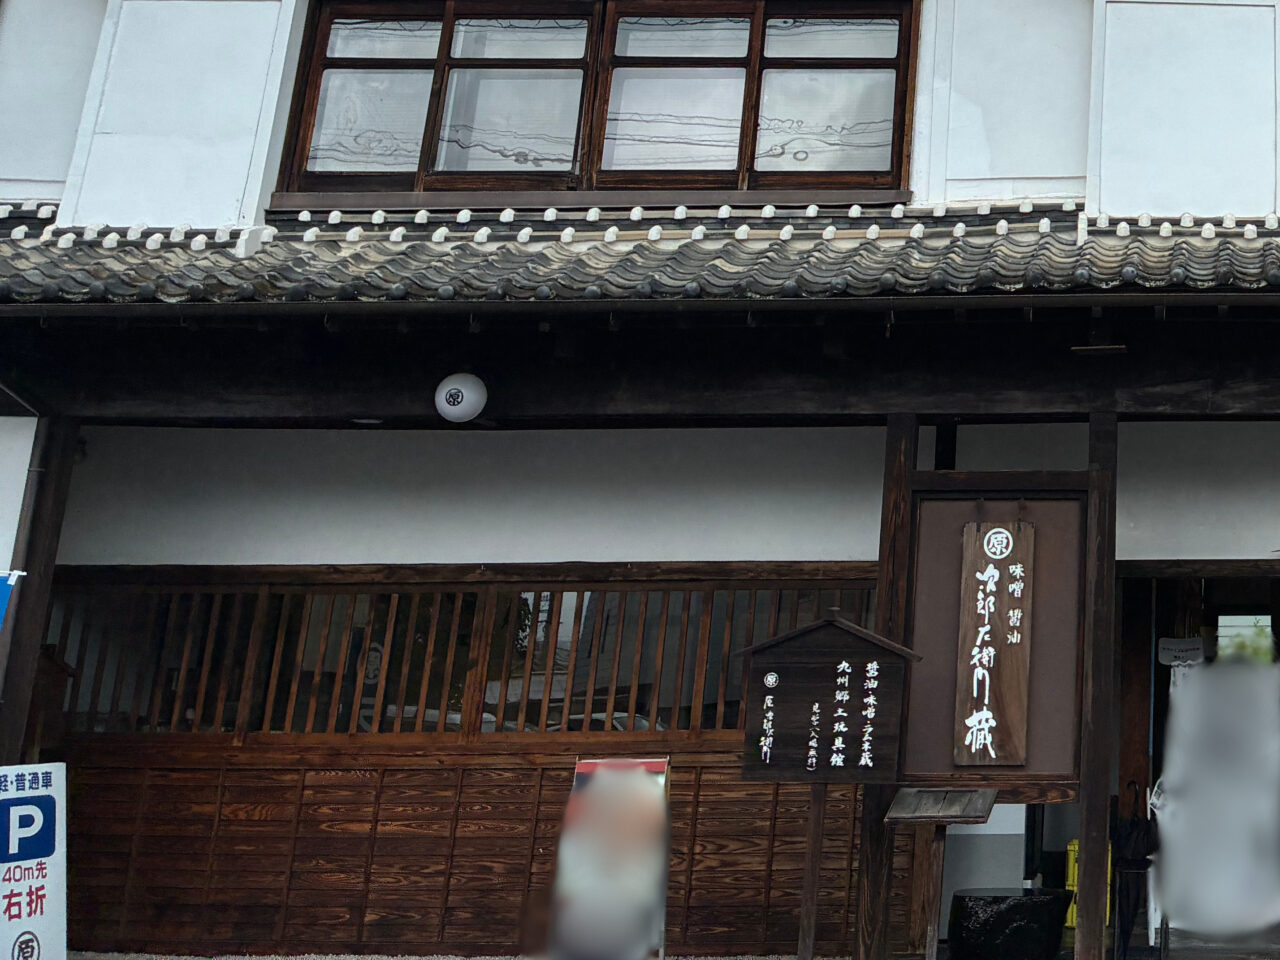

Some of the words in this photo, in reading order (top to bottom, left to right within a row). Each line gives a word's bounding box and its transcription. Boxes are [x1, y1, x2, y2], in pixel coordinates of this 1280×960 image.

[829, 660, 852, 767] 九州郷土玩具館
[9, 805, 44, 855] P
[2, 860, 48, 884] 40m先
[2, 884, 47, 922] 右折
